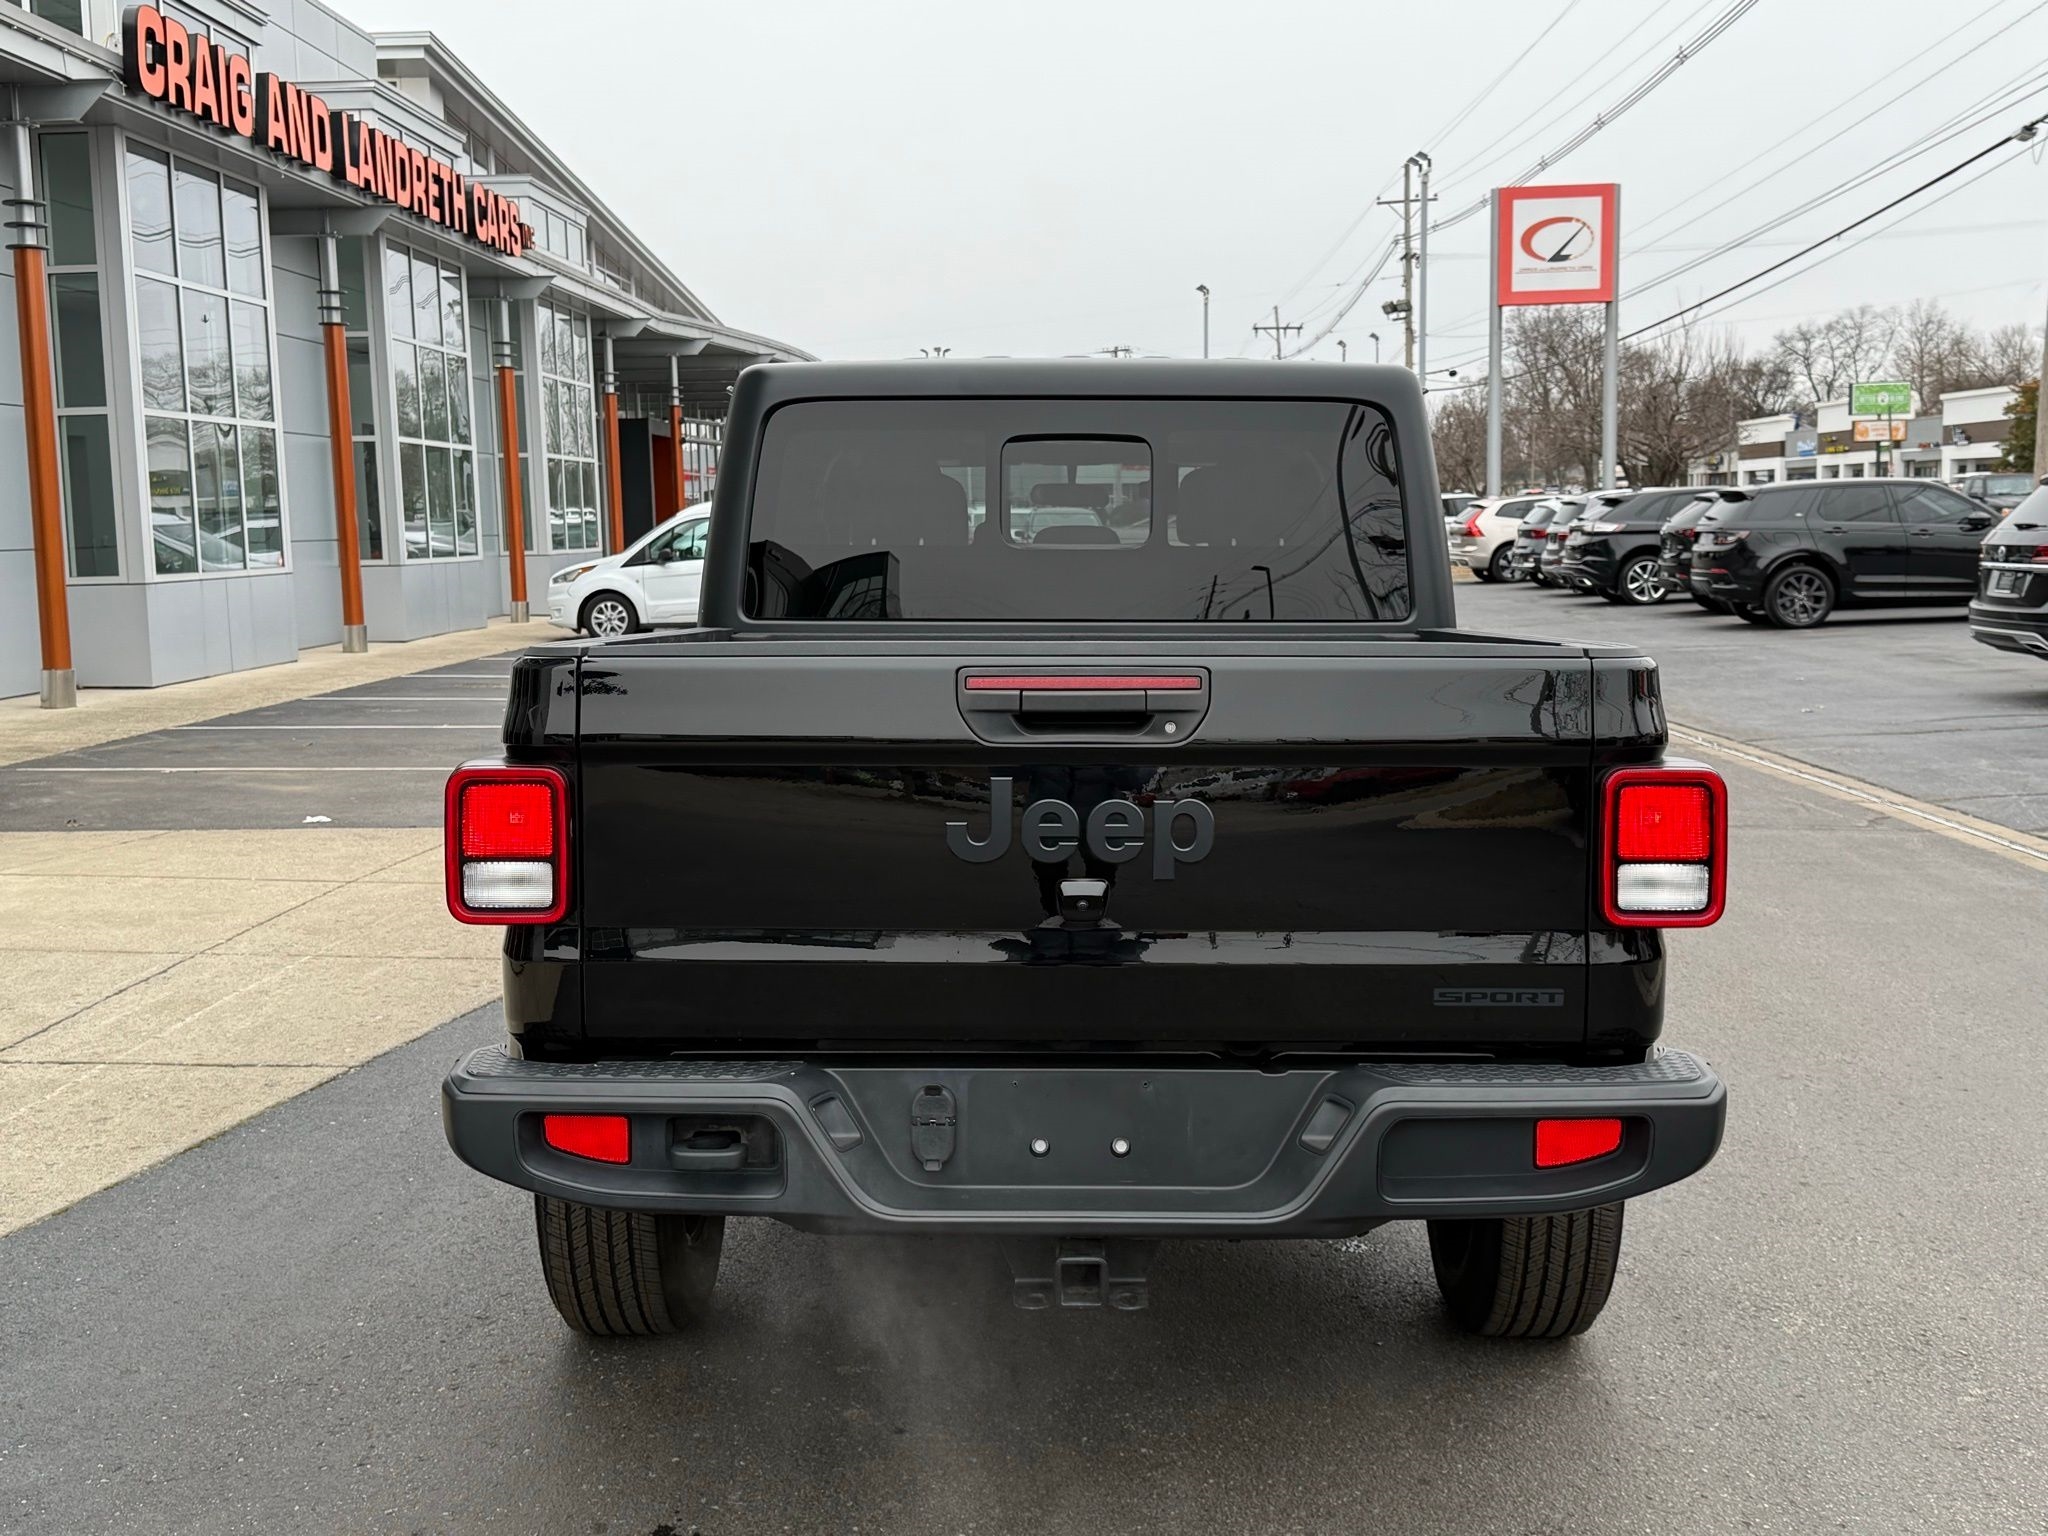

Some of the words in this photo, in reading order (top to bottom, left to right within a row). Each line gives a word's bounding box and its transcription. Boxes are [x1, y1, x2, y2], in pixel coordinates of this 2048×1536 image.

[135, 4, 254, 138] CRAIG
[266, 72, 333, 173] AND
[340, 111, 469, 235] LANDRETH
[472, 181, 523, 258] CARS
[945, 776, 1216, 881] Jeep
[1434, 990, 1565, 1005] SPORT
